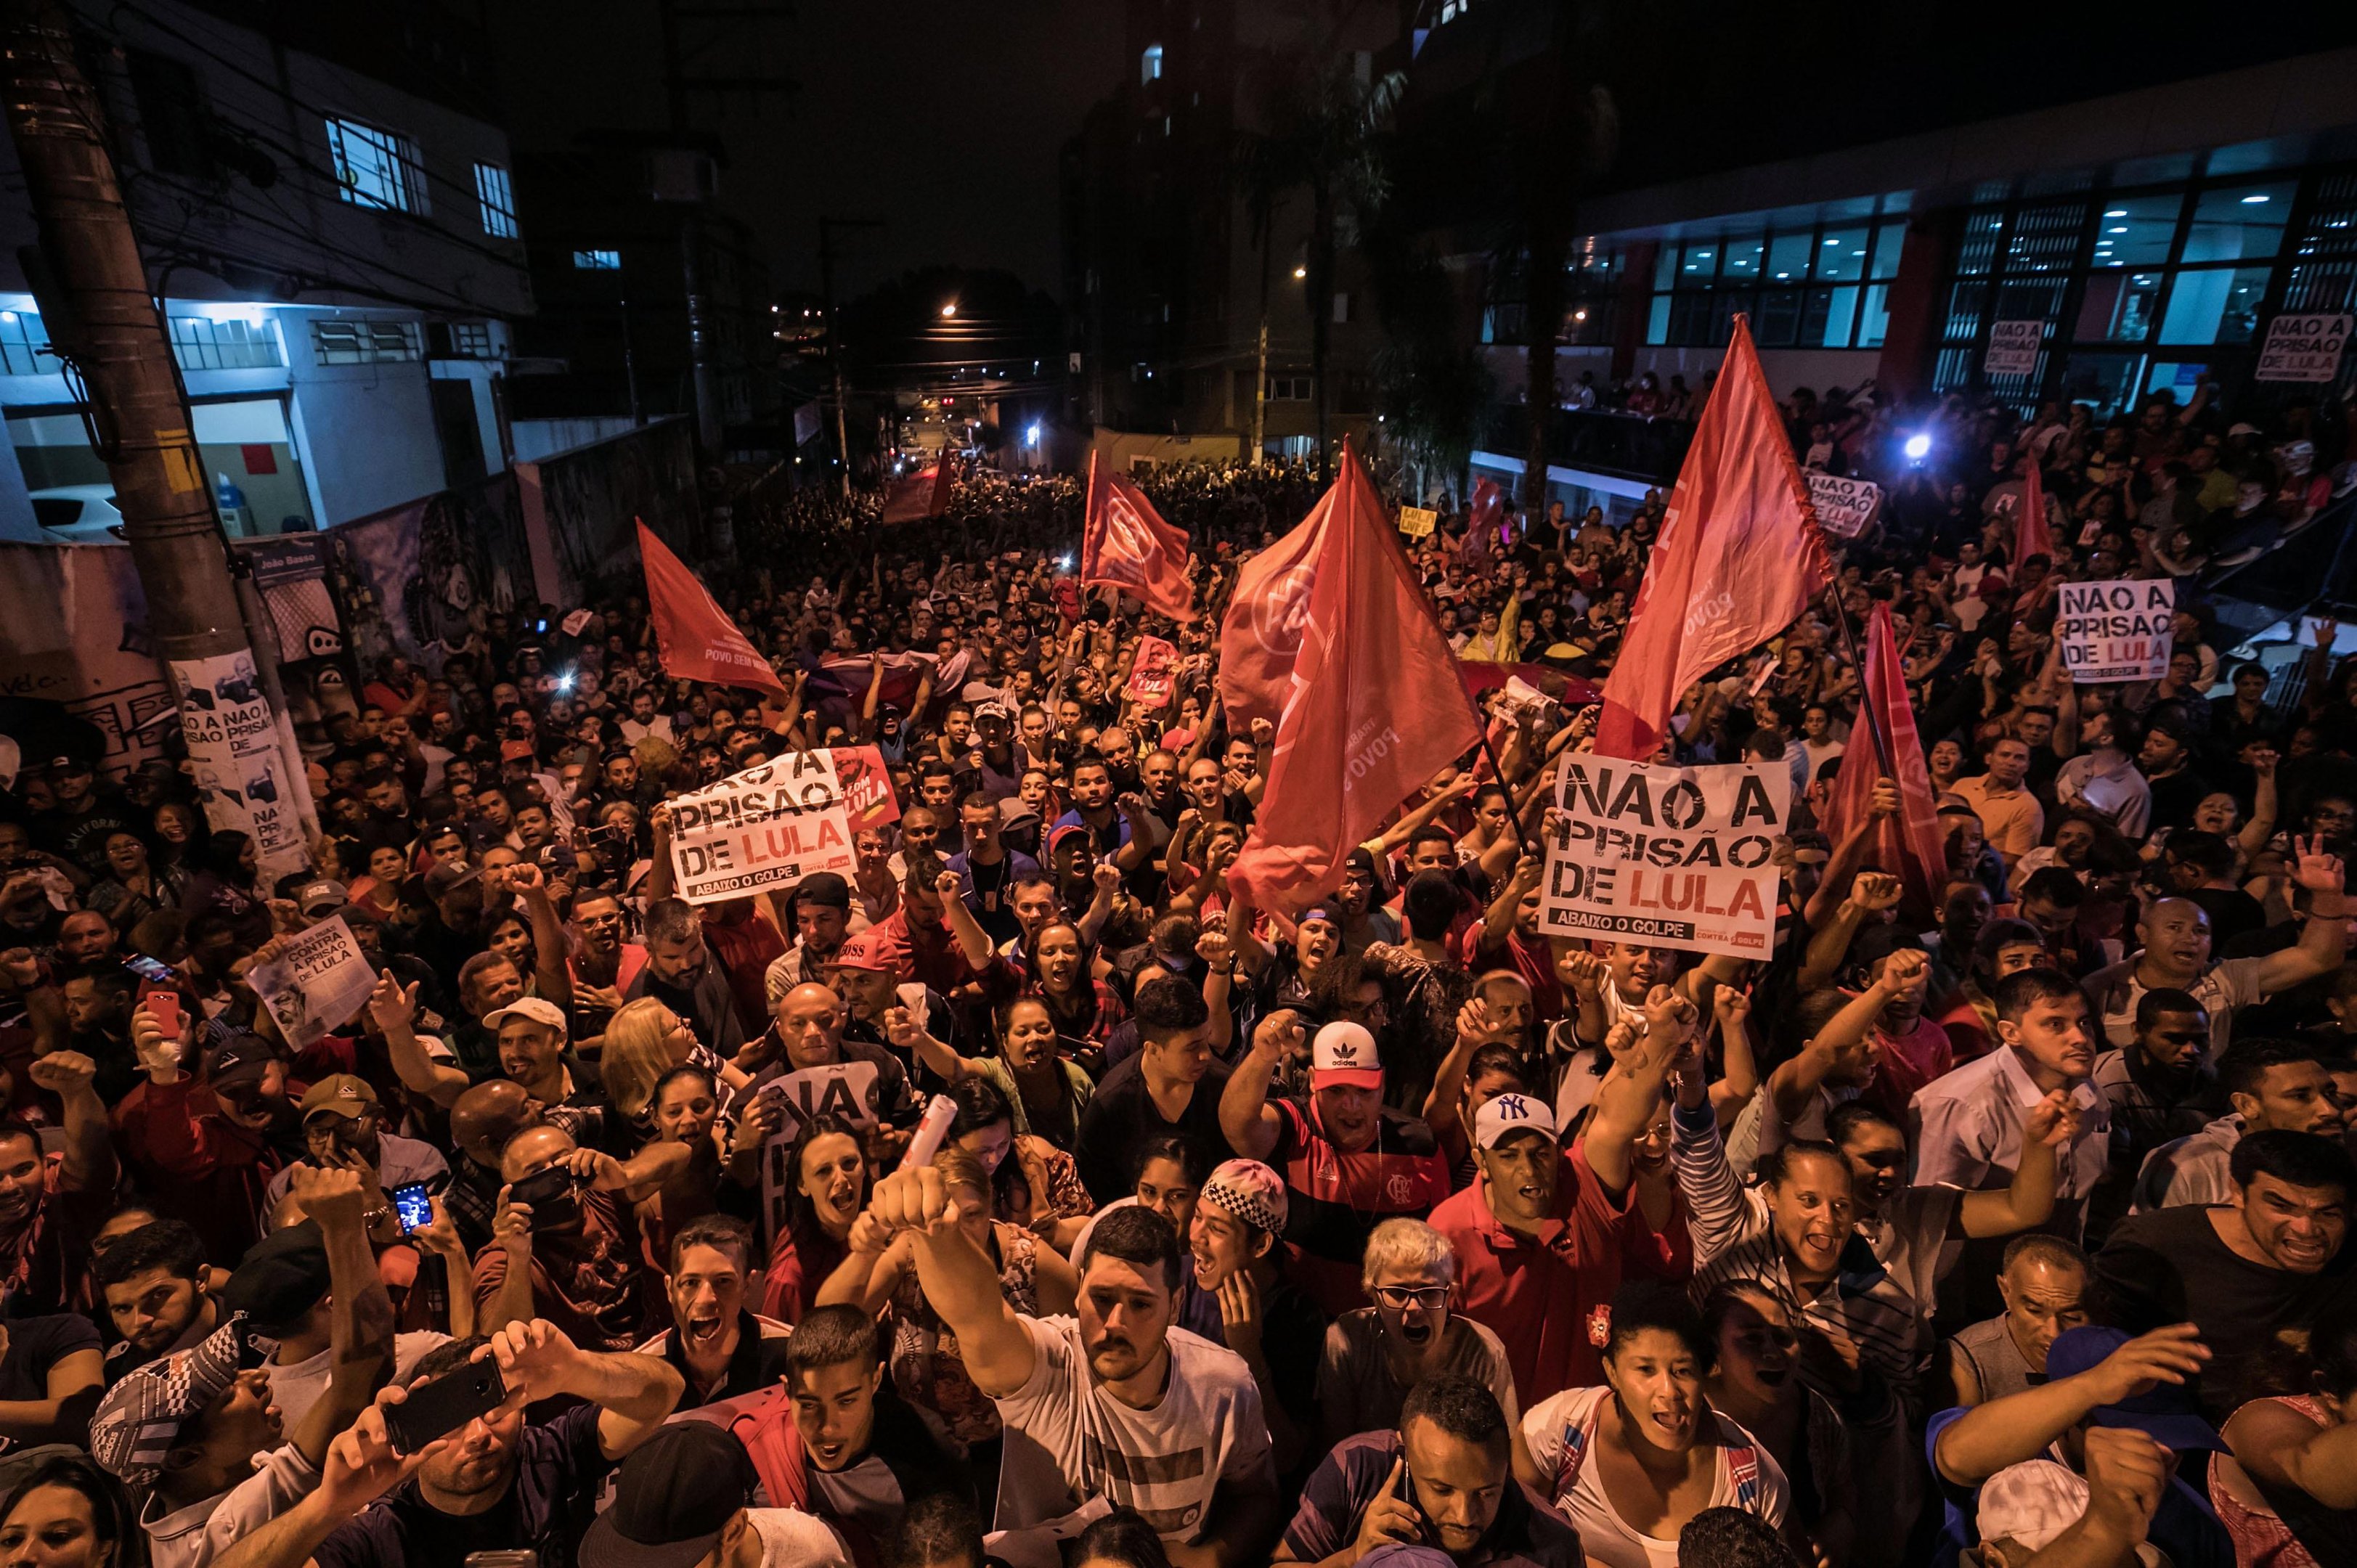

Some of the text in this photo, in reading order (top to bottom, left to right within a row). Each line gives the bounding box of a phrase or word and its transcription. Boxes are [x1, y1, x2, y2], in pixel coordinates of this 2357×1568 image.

[2287, 356, 2333, 369] LULA
[285, 554, 316, 565] Basso
[705, 649, 732, 663] POVO
[733, 653, 752, 667] SEM
[2067, 640, 2165, 664] DE LULA
[230, 739, 251, 751] DE
[844, 780, 888, 819] LULA
[847, 775, 871, 797] COM
[1563, 763, 1778, 830] NÃO À
[672, 782, 834, 841] PRISÃO
[261, 836, 280, 849] DE
[678, 819, 844, 878] DE LULA
[1558, 816, 1772, 869] PRISÃO
[695, 866, 793, 897] ABAIXO O GOLPE
[1550, 859, 1765, 920] DE LULA
[1557, 910, 1685, 939] ABAIXO O GOLPE
[1696, 932, 1729, 942] CONTRA
[1737, 936, 1764, 947] GOLPE
[288, 931, 343, 963] CONTRA
[294, 963, 303, 973] A
[298, 949, 353, 982] DE LULA
[102, 1431, 119, 1464] adidas
